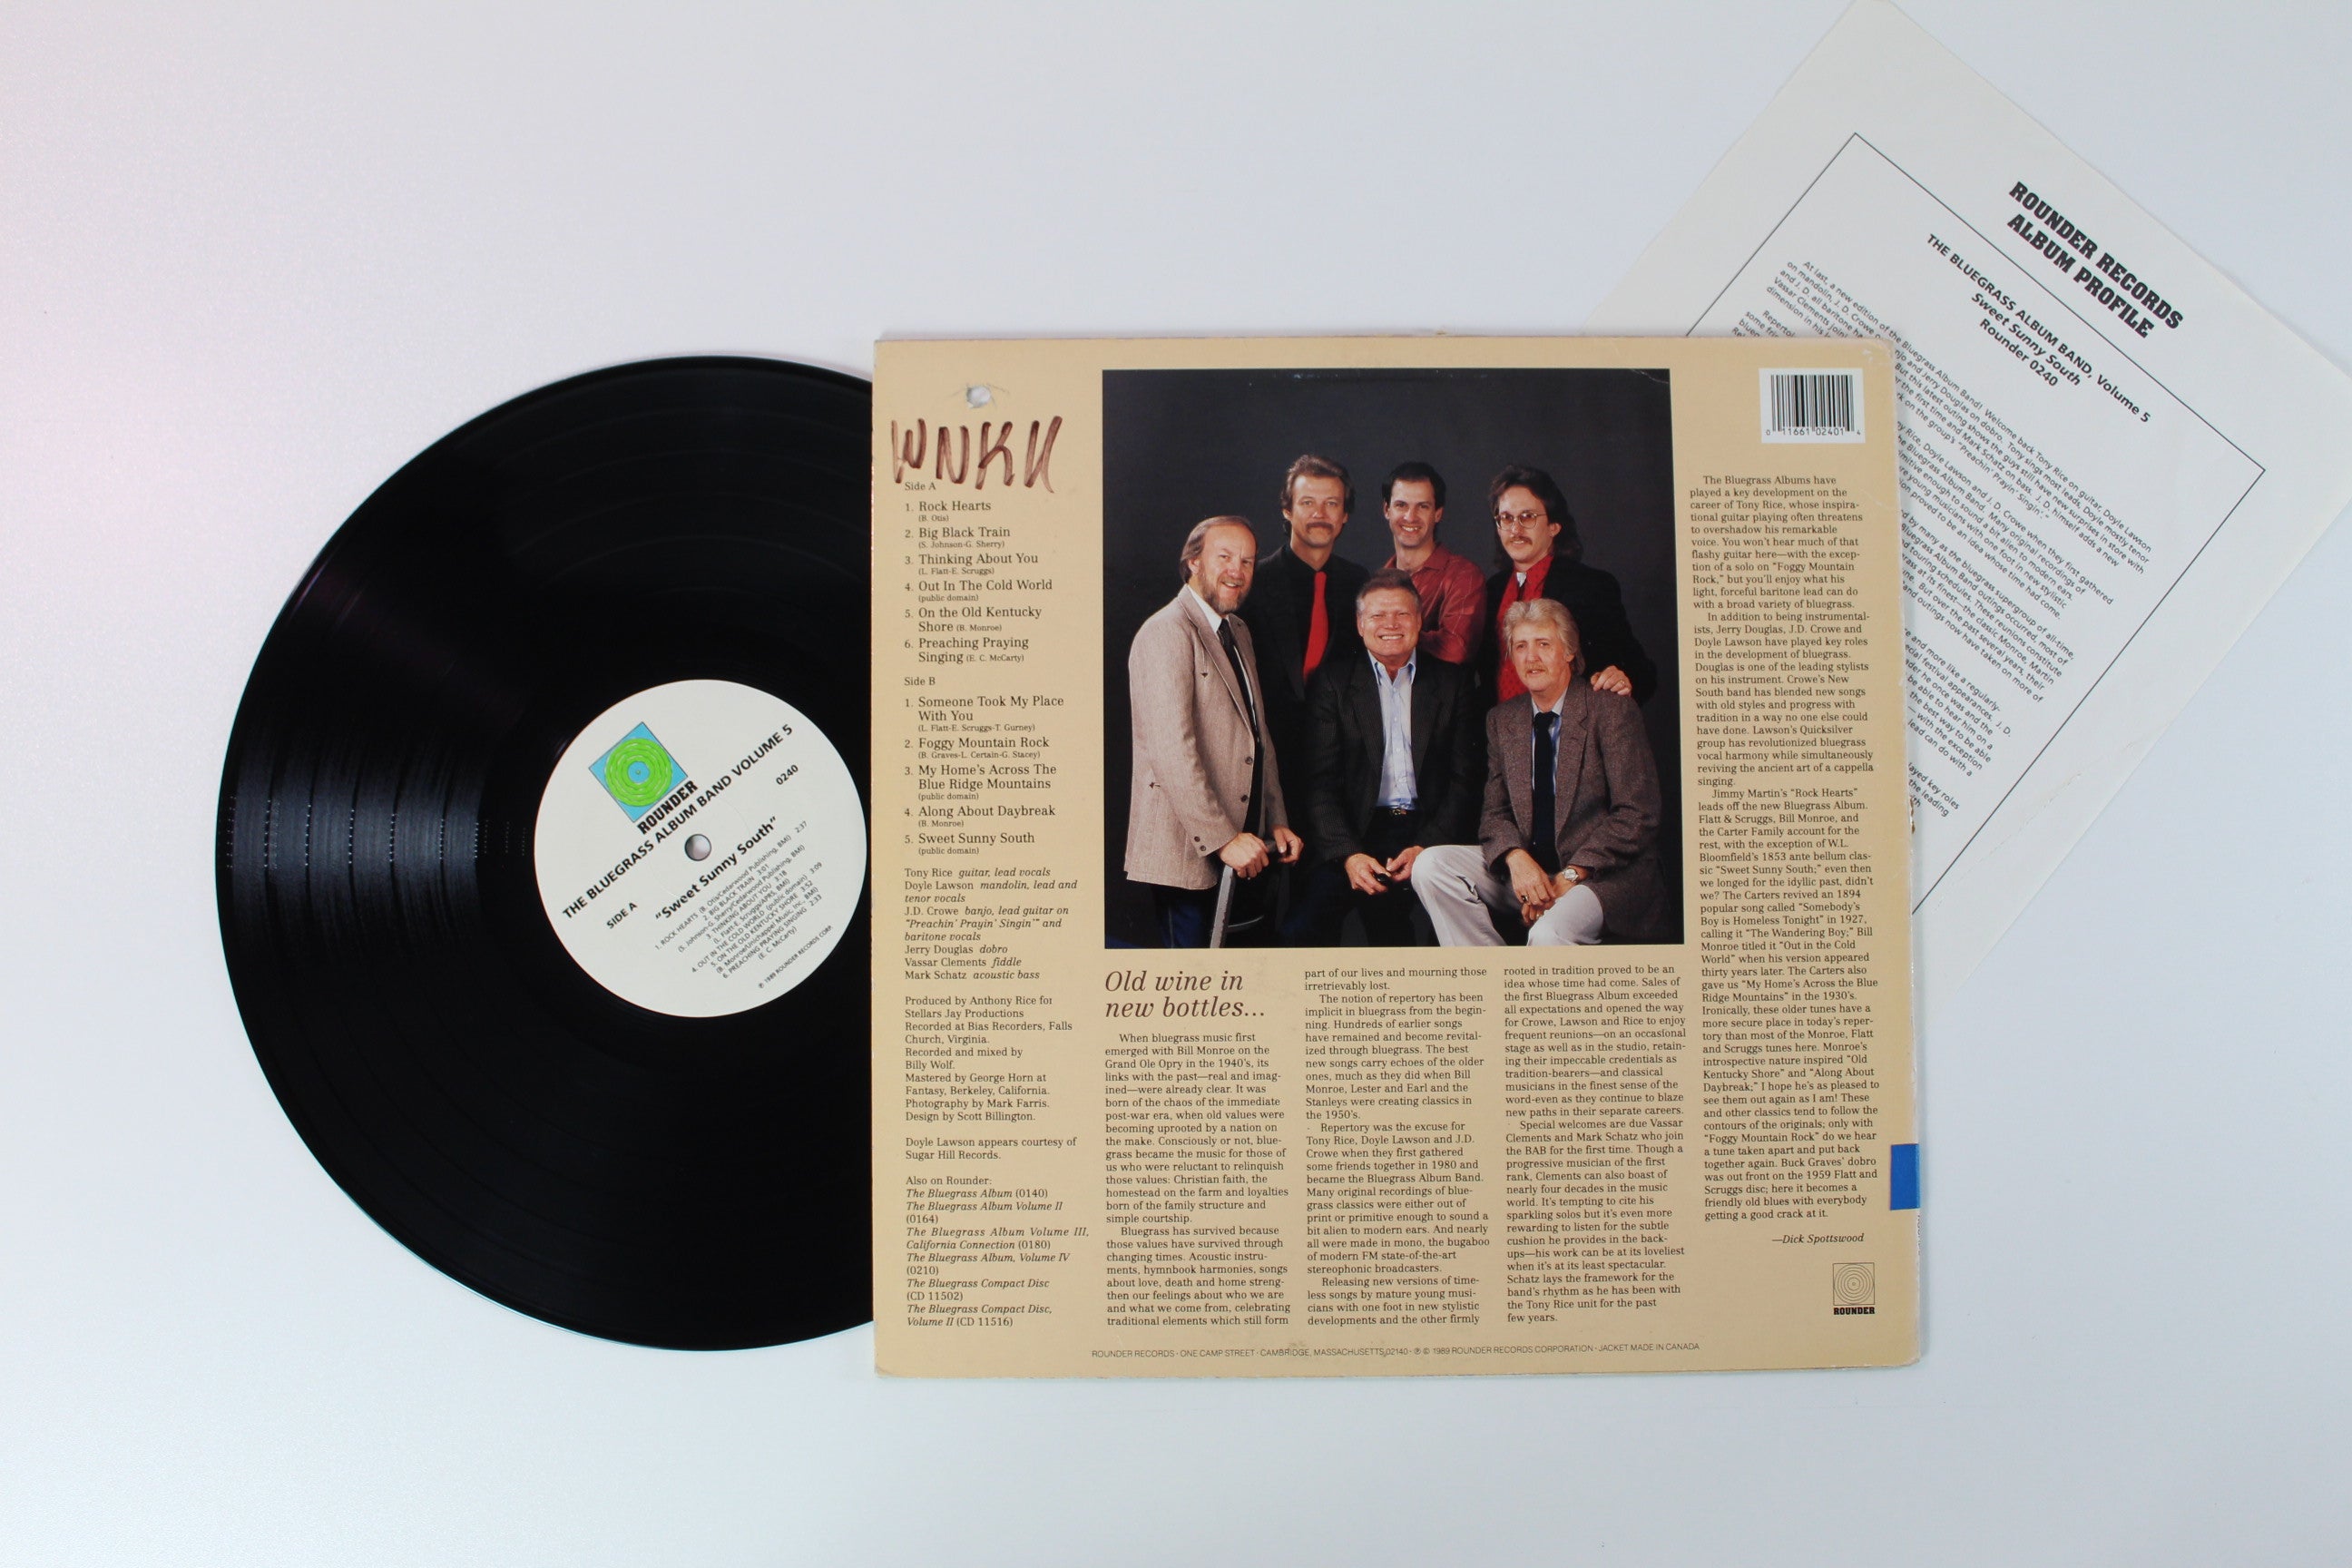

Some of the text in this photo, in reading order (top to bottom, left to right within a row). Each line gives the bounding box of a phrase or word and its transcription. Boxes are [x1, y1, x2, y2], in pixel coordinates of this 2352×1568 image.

[2009, 181, 2183, 329] ROUNDER RECORDS
[2006, 214, 2155, 338] ALBUM PROFILE
[1803, 261, 1814, 271] At
[1814, 269, 1828, 285] last,
[1836, 288, 1853, 303] new
[1852, 302, 1879, 325] edition
[1878, 323, 1890, 333] of
[1888, 329, 1902, 344] the
[1901, 340, 1936, 372] Bluegrass
[1935, 369, 1960, 392] Album
[1927, 233, 2151, 423] THE BLUEGRASS ALBUM BAND, Volume 5
[1971, 293, 2081, 386] Sweet Sunny South
[1979, 318, 2058, 387] Rounder 0240
[1816, 428, 1844, 436] 02401
[905, 481, 936, 491] Side A
[1702, 475, 1837, 486] The Bluegrass Albums have
[919, 500, 947, 512] Rock
[952, 500, 992, 511] Hearts
[919, 527, 938, 541] Big
[942, 526, 975, 538] Black
[977, 526, 1011, 537] Train
[918, 554, 973, 567] Thinking
[975, 553, 1013, 564] About
[1015, 553, 1038, 564] You
[918, 580, 940, 592] Out
[944, 581, 956, 591] In
[959, 580, 983, 591] The
[985, 579, 1013, 591] Cold
[1016, 579, 1053, 590] World
[918, 593, 979, 603] (public domain)
[918, 607, 935, 618] On
[939, 606, 958, 618] the
[961, 606, 982, 618] Old
[986, 605, 1042, 620] Kentucky
[918, 621, 954, 632] Shore
[919, 637, 979, 651] Preaching
[983, 636, 1029, 651] Praying
[918, 652, 964, 665] Singing
[989, 653, 1024, 663] McCarty)
[904, 676, 936, 686] Side B
[918, 696, 974, 708] Someone
[977, 695, 1006, 707] Took
[1010, 695, 1029, 710] My
[1033, 695, 1063, 706] Place
[918, 710, 973, 721] With You
[918, 737, 955, 750] Foggy
[958, 737, 1016, 748] Mountain
[1020, 736, 1050, 748] Rock
[776, 764, 799, 785] 0240
[918, 764, 937, 779] My
[941, 764, 985, 775] Home's
[989, 764, 1030, 775] Across
[1033, 763, 1057, 774] The
[918, 778, 1051, 792] Blue Ridge Mountains
[637, 780, 698, 835] ROUNDER
[918, 805, 954, 819] Along
[957, 805, 994, 817] About
[997, 804, 1055, 818] Daybreak
[562, 724, 792, 918] THE BLUEGRASS ALBUM BAND VOLUME 5
[918, 832, 955, 844] Sweet
[958, 832, 996, 847] Sunny
[1000, 832, 1034, 844] South
[699, 853, 738, 887] Sunny
[904, 867, 1051, 879] Tony Rice guitar, lead vocals
[606, 902, 637, 929] SIDE A
[905, 944, 1008, 956] Jerry Douglas dobro
[1105, 970, 1243, 992] Old wine in
[1305, 980, 1390, 993] irretrievably lost.
[1504, 989, 1678, 1003] the first Bluegrass Album exceeded
[1105, 1003, 1154, 1018] new
[1119, 1032, 1256, 1044] When bluegrass music first
[906, 1098, 1050, 1111] Photography by Mark Farris.
[906, 1188, 1048, 1200] The Bluegrass Album (0140)
[1807, 1232, 1865, 1245] Spottswood
[1833, 1306, 1876, 1316] ROUNDER
[1092, 1348, 1256, 1358] ROUNDER RECORDS ONE CAMP STREET
[1598, 1342, 1700, 1353] JACKET MADE IN CANADA
